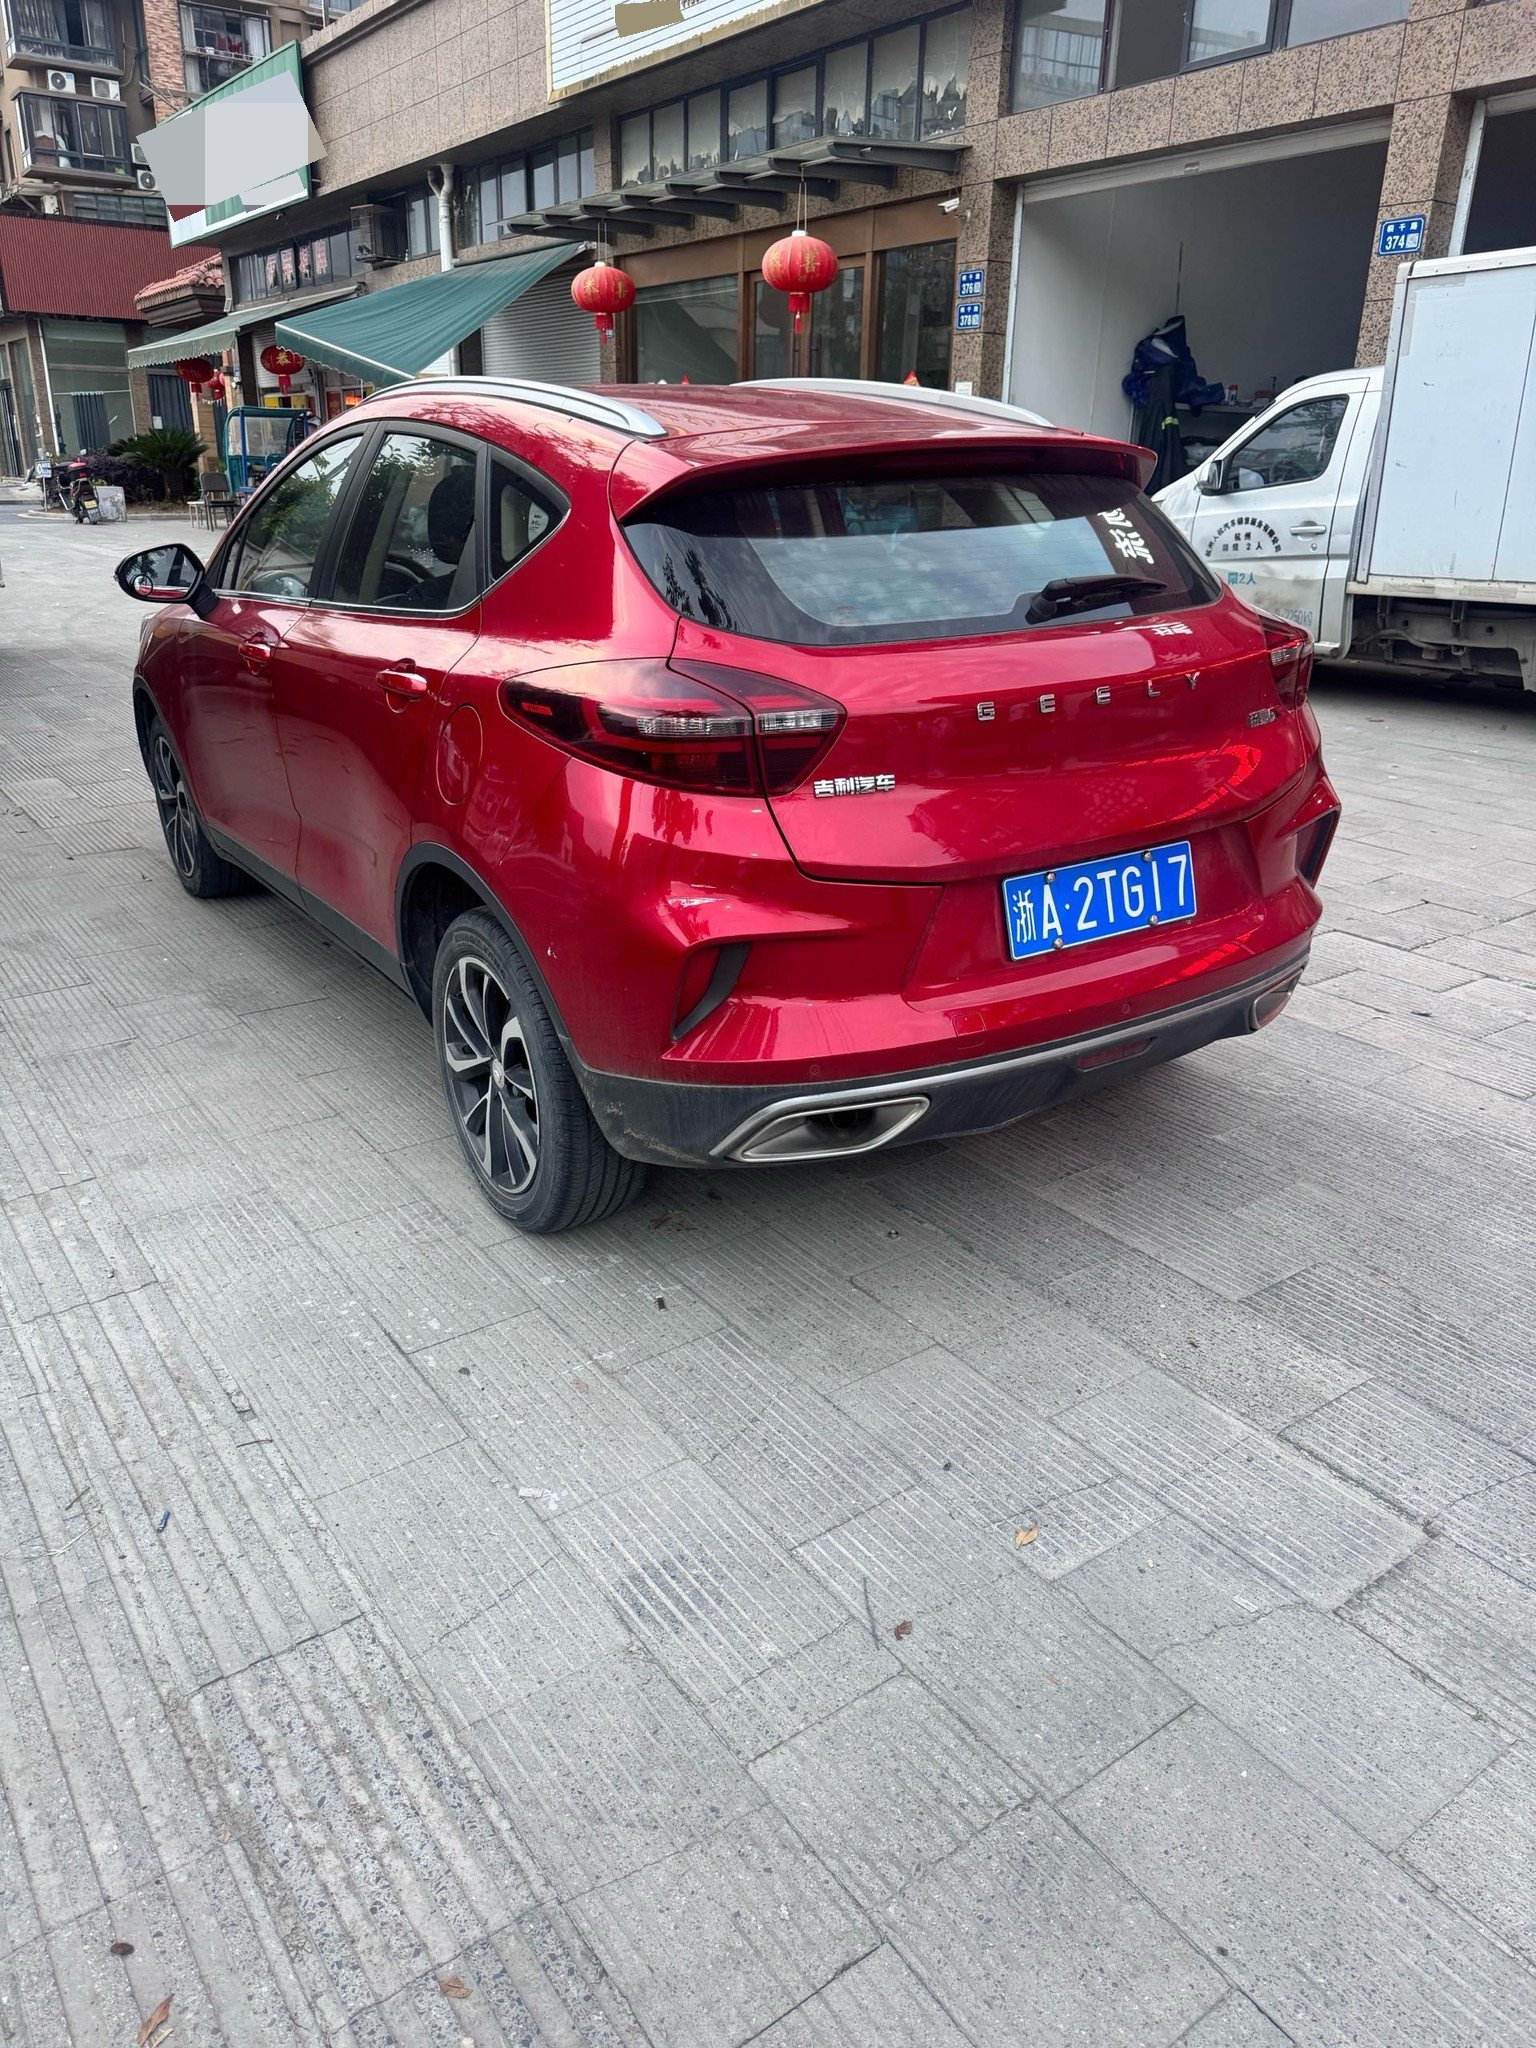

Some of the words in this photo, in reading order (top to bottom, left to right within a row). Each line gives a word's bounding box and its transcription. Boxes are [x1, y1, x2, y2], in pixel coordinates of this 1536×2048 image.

[1385, 234, 1406, 251] 374
[961, 282, 974, 295] 376
[976, 671, 1201, 722] GEELY
[813, 773, 896, 798] 吉利汽车
